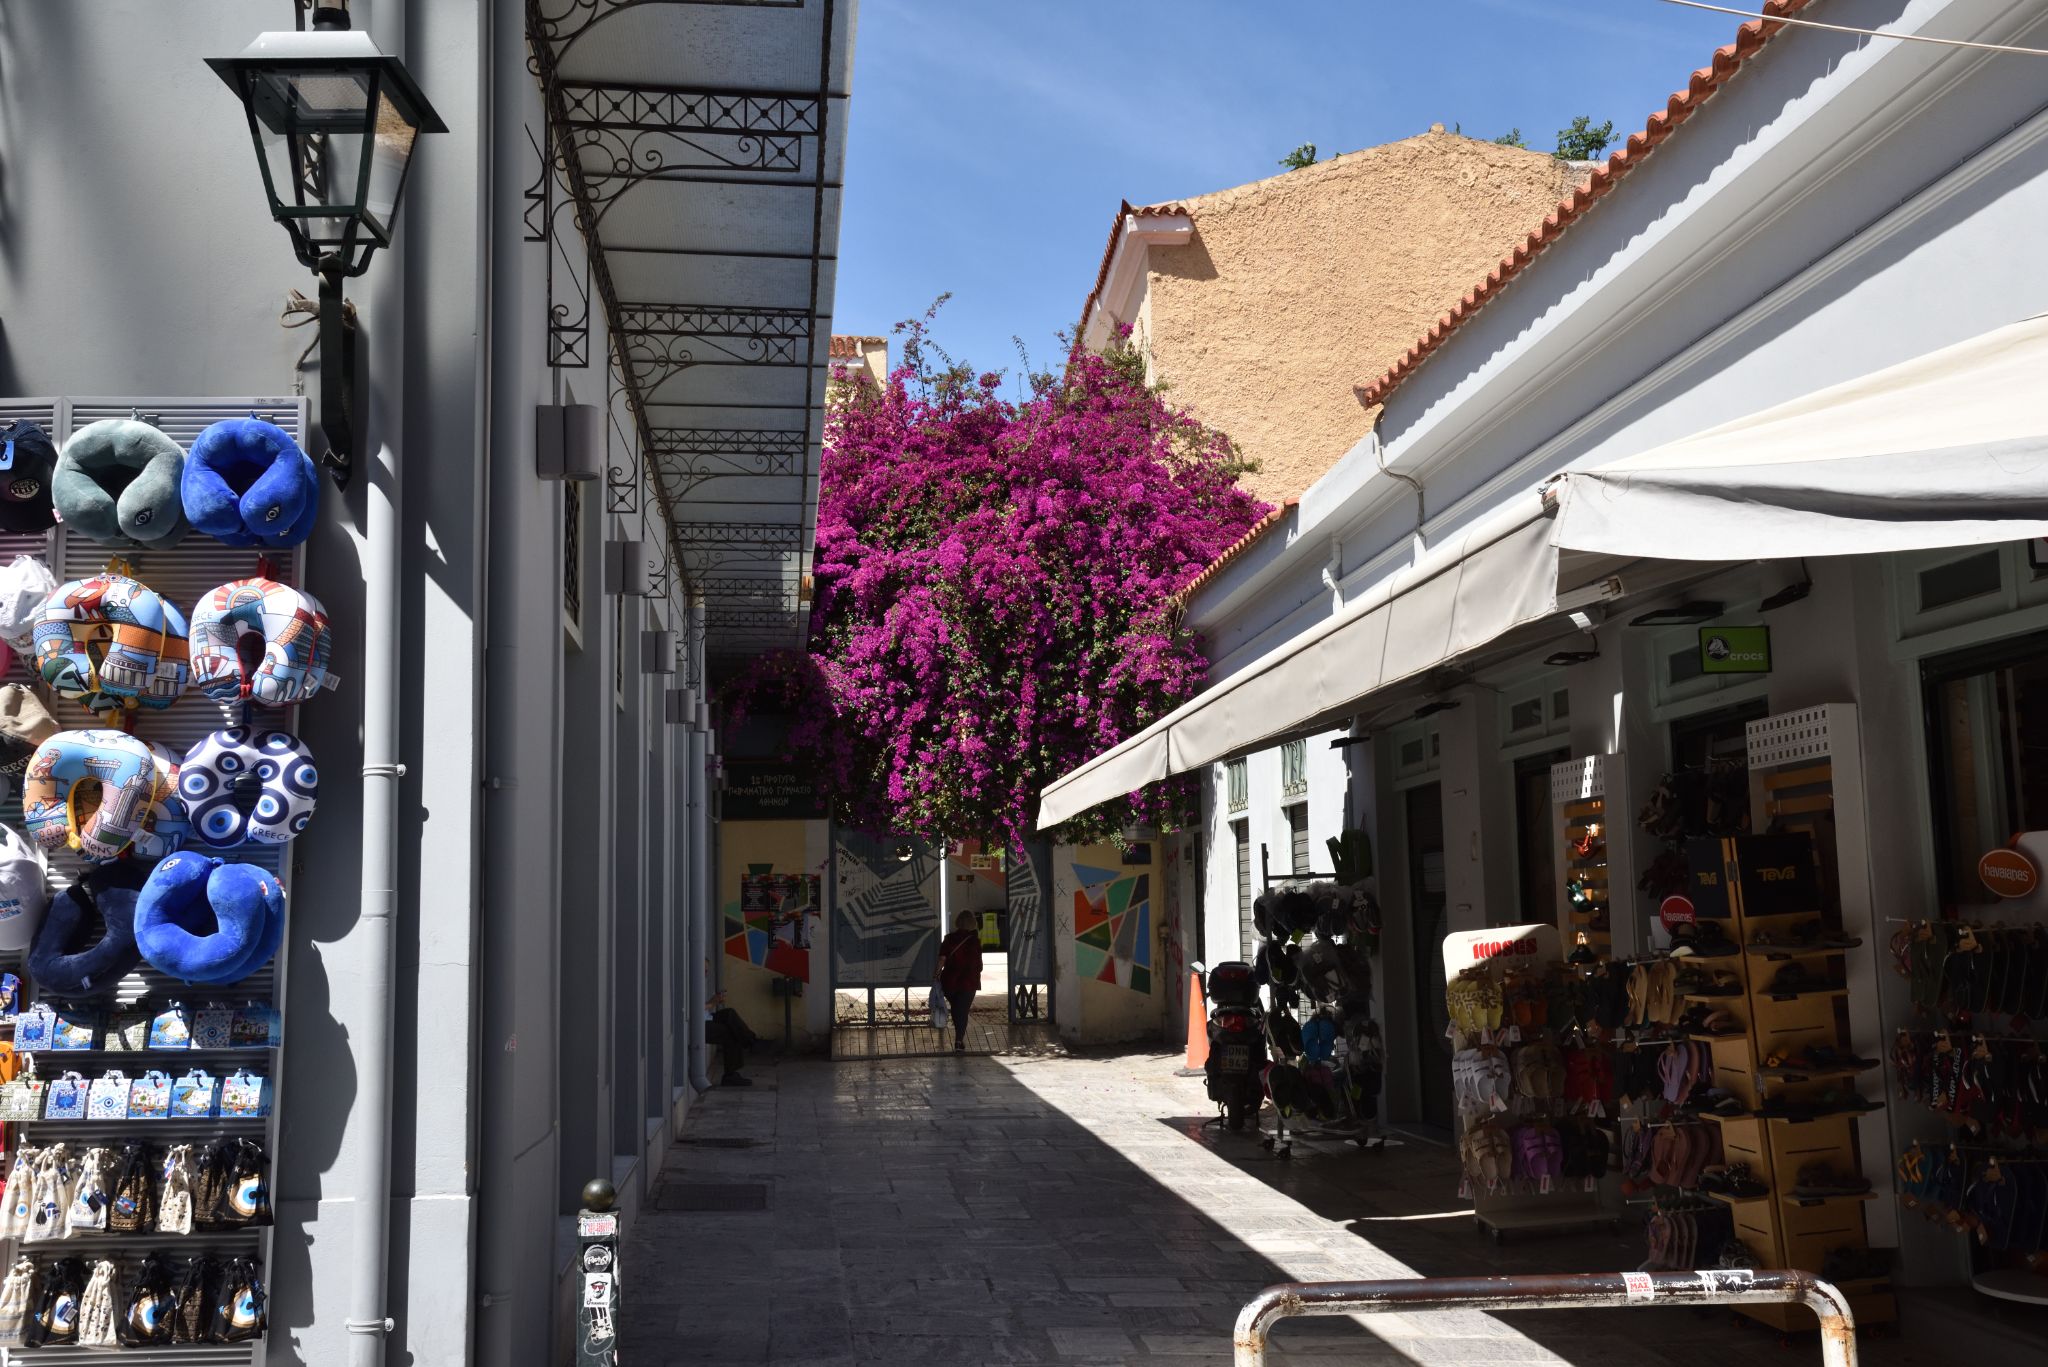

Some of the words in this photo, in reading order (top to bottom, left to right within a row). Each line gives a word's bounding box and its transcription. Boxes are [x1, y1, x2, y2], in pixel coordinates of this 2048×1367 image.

[1730, 652, 1764, 661] crocs
[763, 774, 796, 784] ΠΡΟΤΥΠΟ
[777, 785, 812, 796] ΓΥΜΝΑΣΙΟ
[759, 797, 790, 807] ΑΘΗΝΩΝ
[252, 826, 290, 841] GREECE
[1696, 870, 1718, 886] Teva
[1756, 865, 1797, 882] Teva
[1984, 863, 2030, 882] havaianas
